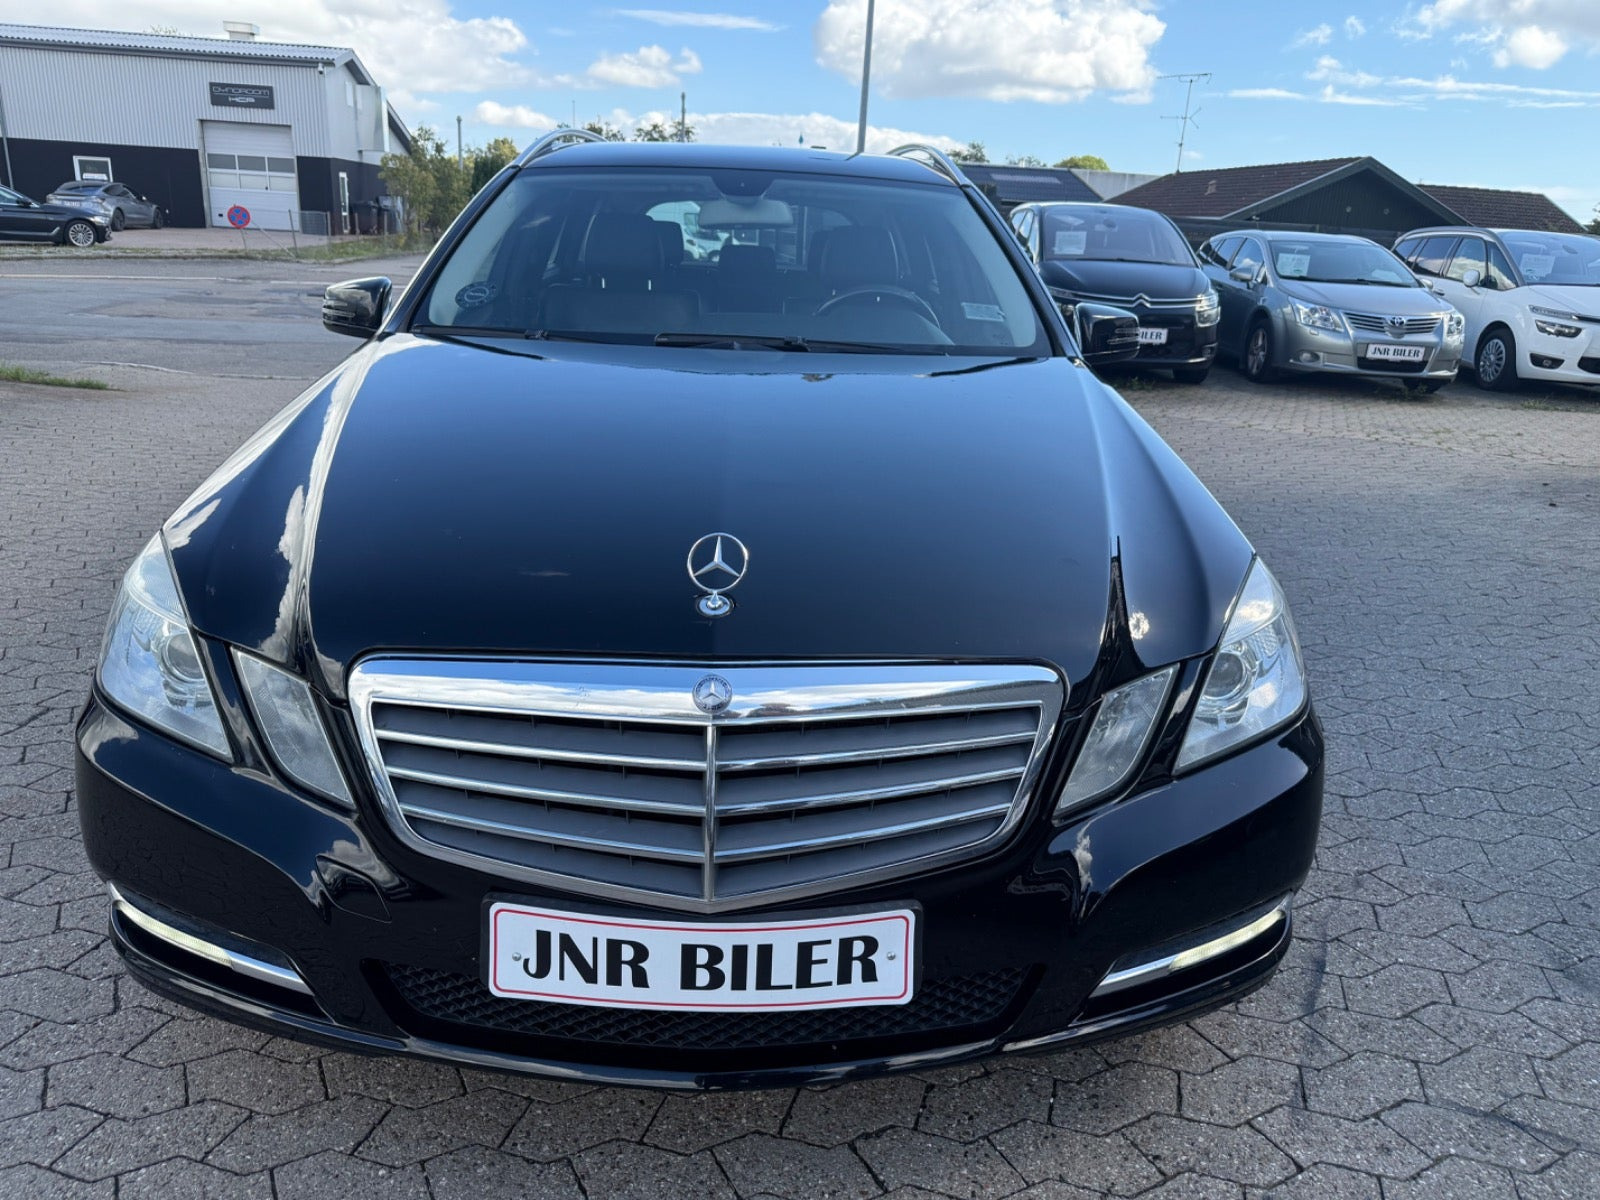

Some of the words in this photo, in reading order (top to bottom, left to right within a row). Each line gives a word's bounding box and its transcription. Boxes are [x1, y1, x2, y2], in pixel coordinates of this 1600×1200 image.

[1371, 347, 1390, 356] JNR
[1392, 347, 1420, 358] BILER
[522, 929, 650, 988] JNR
[680, 935, 879, 991] BILER
